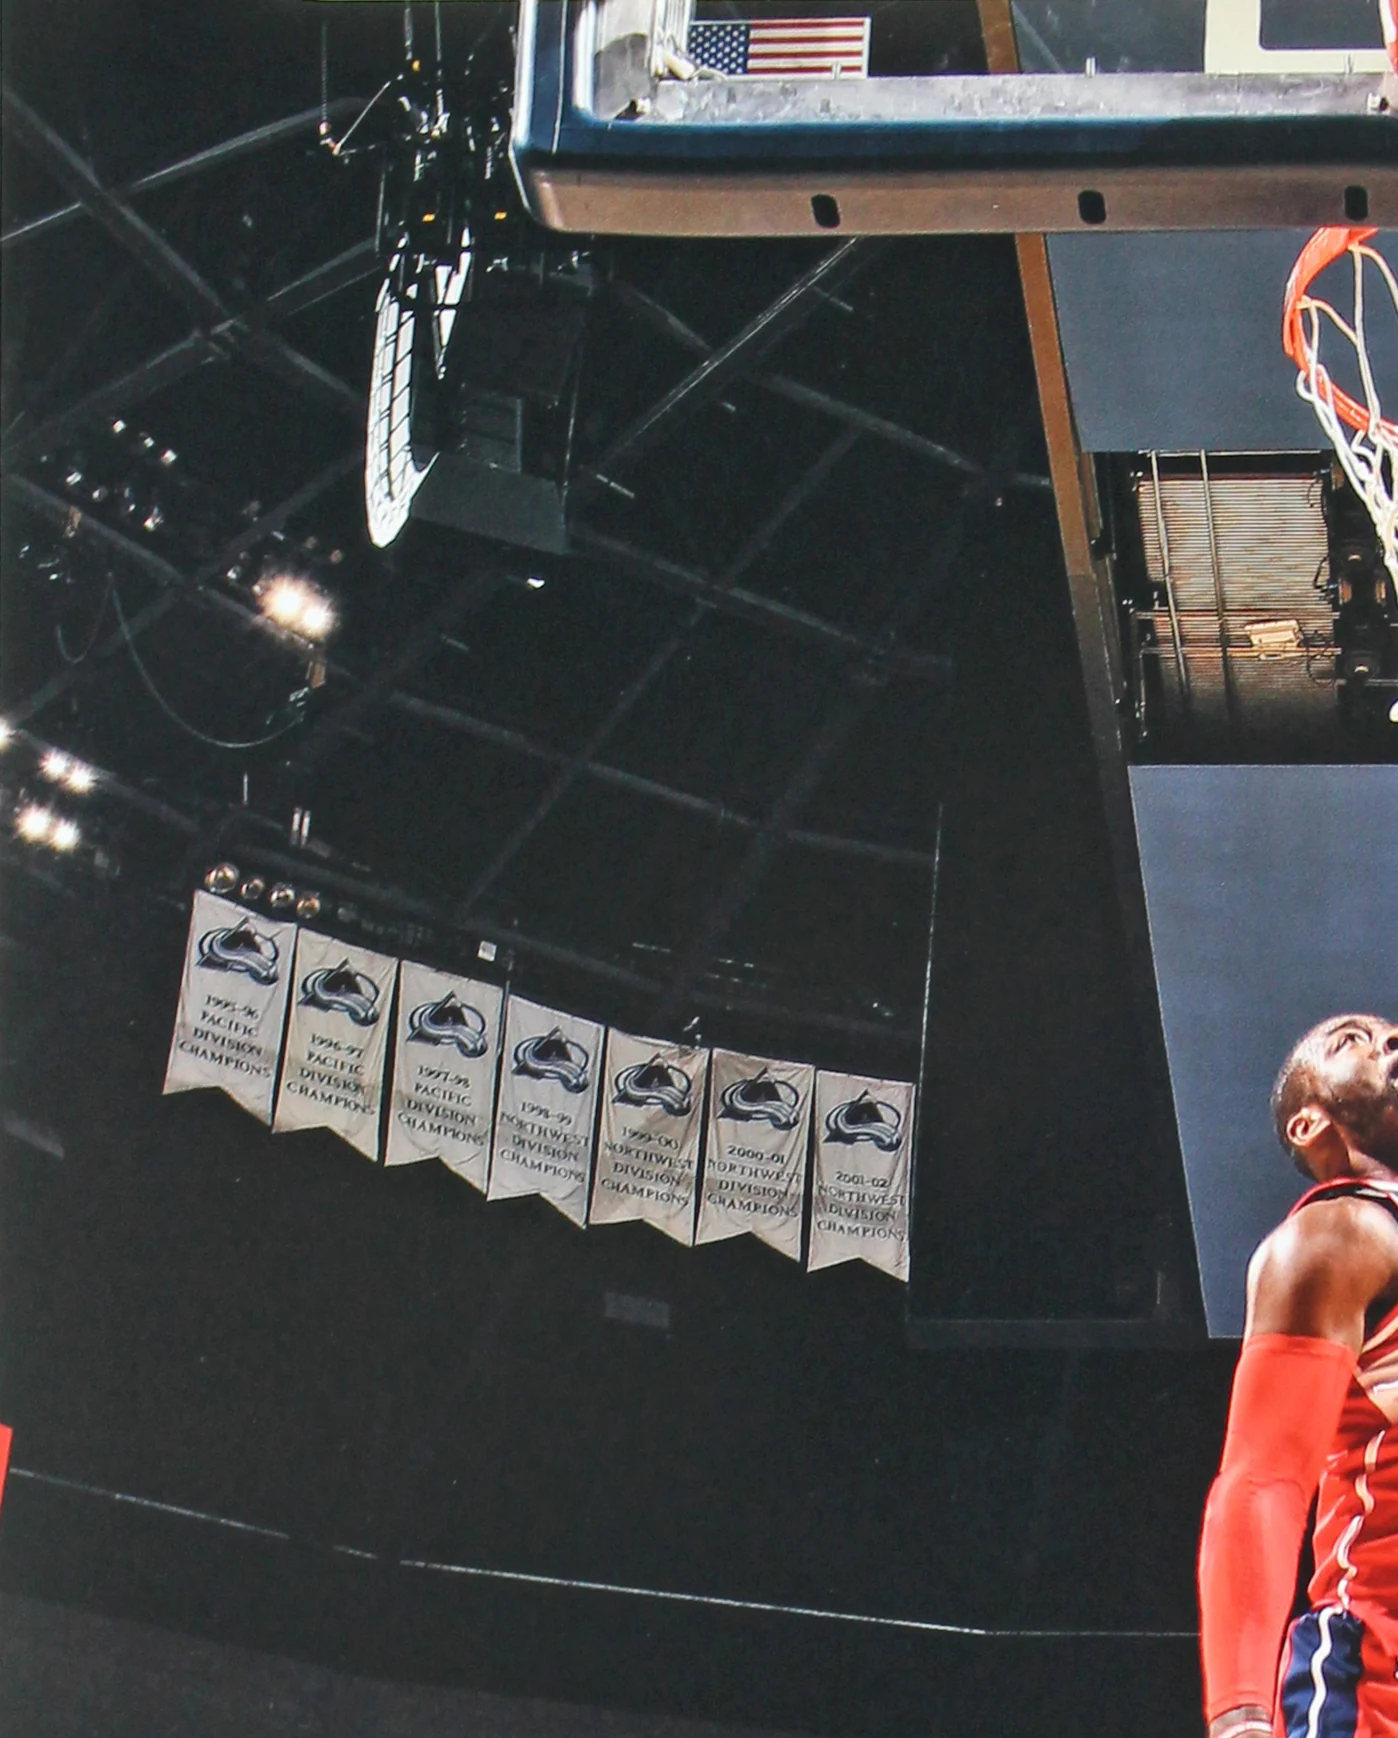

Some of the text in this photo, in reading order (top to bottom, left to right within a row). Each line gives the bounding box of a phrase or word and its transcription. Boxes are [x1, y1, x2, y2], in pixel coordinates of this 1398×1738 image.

[205, 994, 259, 1020] 1995-96
[200, 1011, 259, 1038] PACIFIC
[193, 1027, 263, 1058] DIVISION
[310, 1033, 365, 1060] 1996-97
[179, 1041, 271, 1079] CHAMPIONS
[306, 1051, 365, 1077] PACIFIC
[300, 1066, 367, 1096] DIVISION
[417, 1065, 470, 1089] 1997-98
[286, 1081, 375, 1116] CHAMPIONS
[415, 1083, 472, 1108] PACIFIC
[407, 1100, 477, 1126] DIVISION
[397, 1112, 485, 1148] CHAMPIONS
[500, 1111, 589, 1147] NORTHWEST
[512, 1134, 579, 1162] DIVISION
[604, 1141, 694, 1169] NORTHWEST
[728, 1145, 784, 1165] 2000-01
[500, 1149, 585, 1183] CHAMPIONS
[613, 1162, 682, 1186] DIVISION
[707, 1159, 800, 1185] NORTHWEST
[835, 1170, 888, 1188] 2001-02
[601, 1178, 689, 1207] CHAMPIONS
[718, 1179, 788, 1199] DIVISION
[818, 1185, 905, 1207] NORTHWEST
[706, 1193, 798, 1218] CHAMPIONS
[828, 1203, 895, 1222] DIVISION
[816, 1220, 905, 1242] CHAMPIONS
